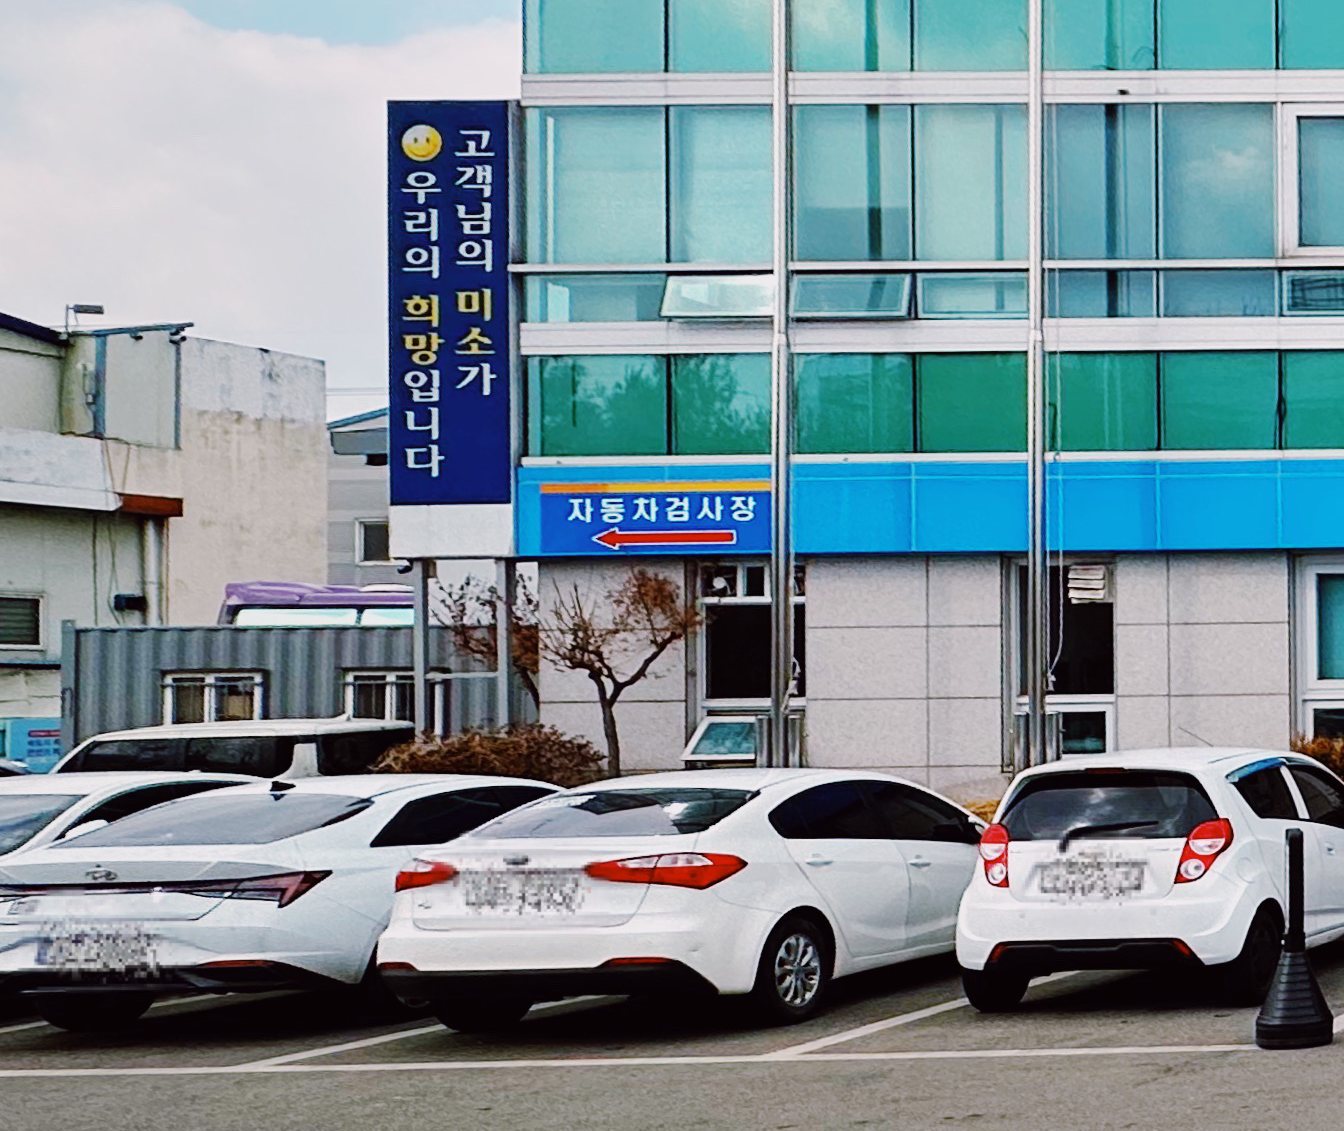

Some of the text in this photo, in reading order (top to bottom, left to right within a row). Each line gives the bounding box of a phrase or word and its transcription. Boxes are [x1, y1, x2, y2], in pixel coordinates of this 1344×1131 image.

[400, 171, 445, 479] 우리의 희망입니다
[453, 128, 498, 398] 고객님의 미소가
[567, 496, 757, 524] 자동차검사장
